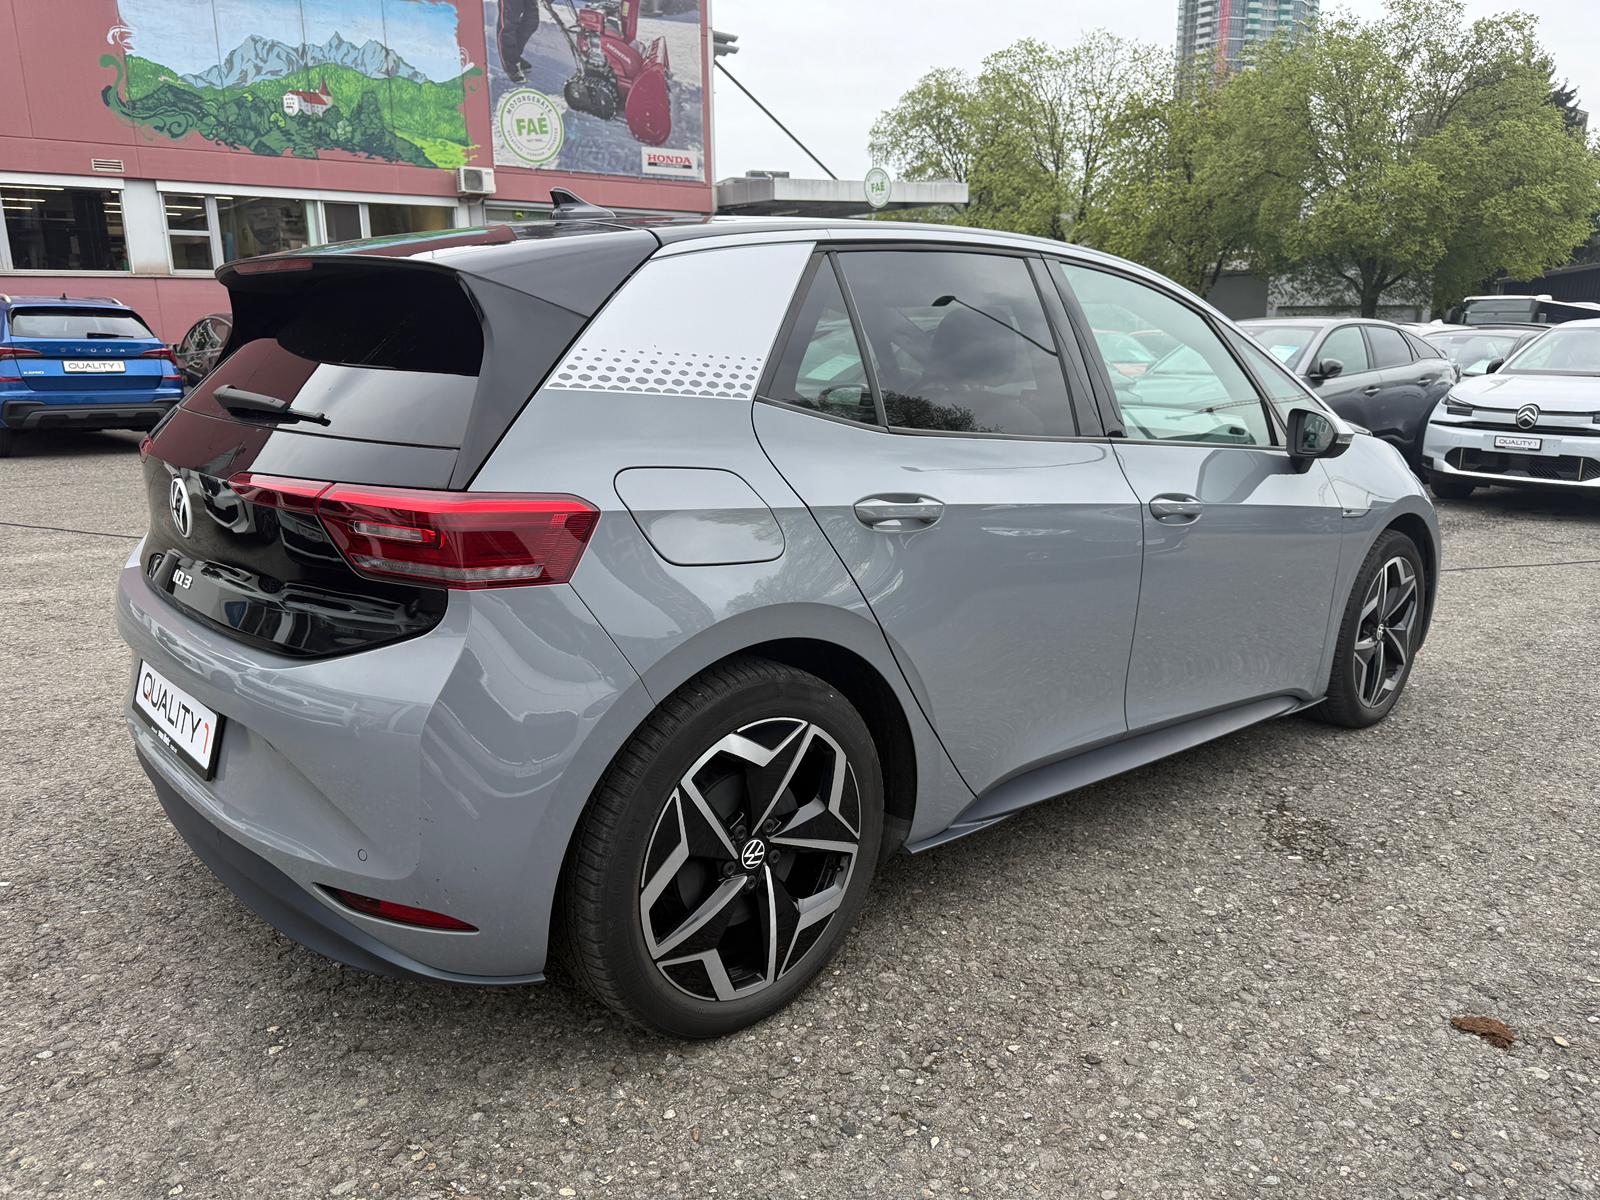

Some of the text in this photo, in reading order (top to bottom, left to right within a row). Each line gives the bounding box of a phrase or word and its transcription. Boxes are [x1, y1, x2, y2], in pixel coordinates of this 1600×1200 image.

[515, 112, 549, 137] FAÉ
[647, 154, 692, 165] HONDA
[68, 362, 115, 370] QUALITY
[1499, 439, 1532, 447] QUALITY
[143, 672, 202, 744] QUALITY
[203, 722, 210, 755] 1
